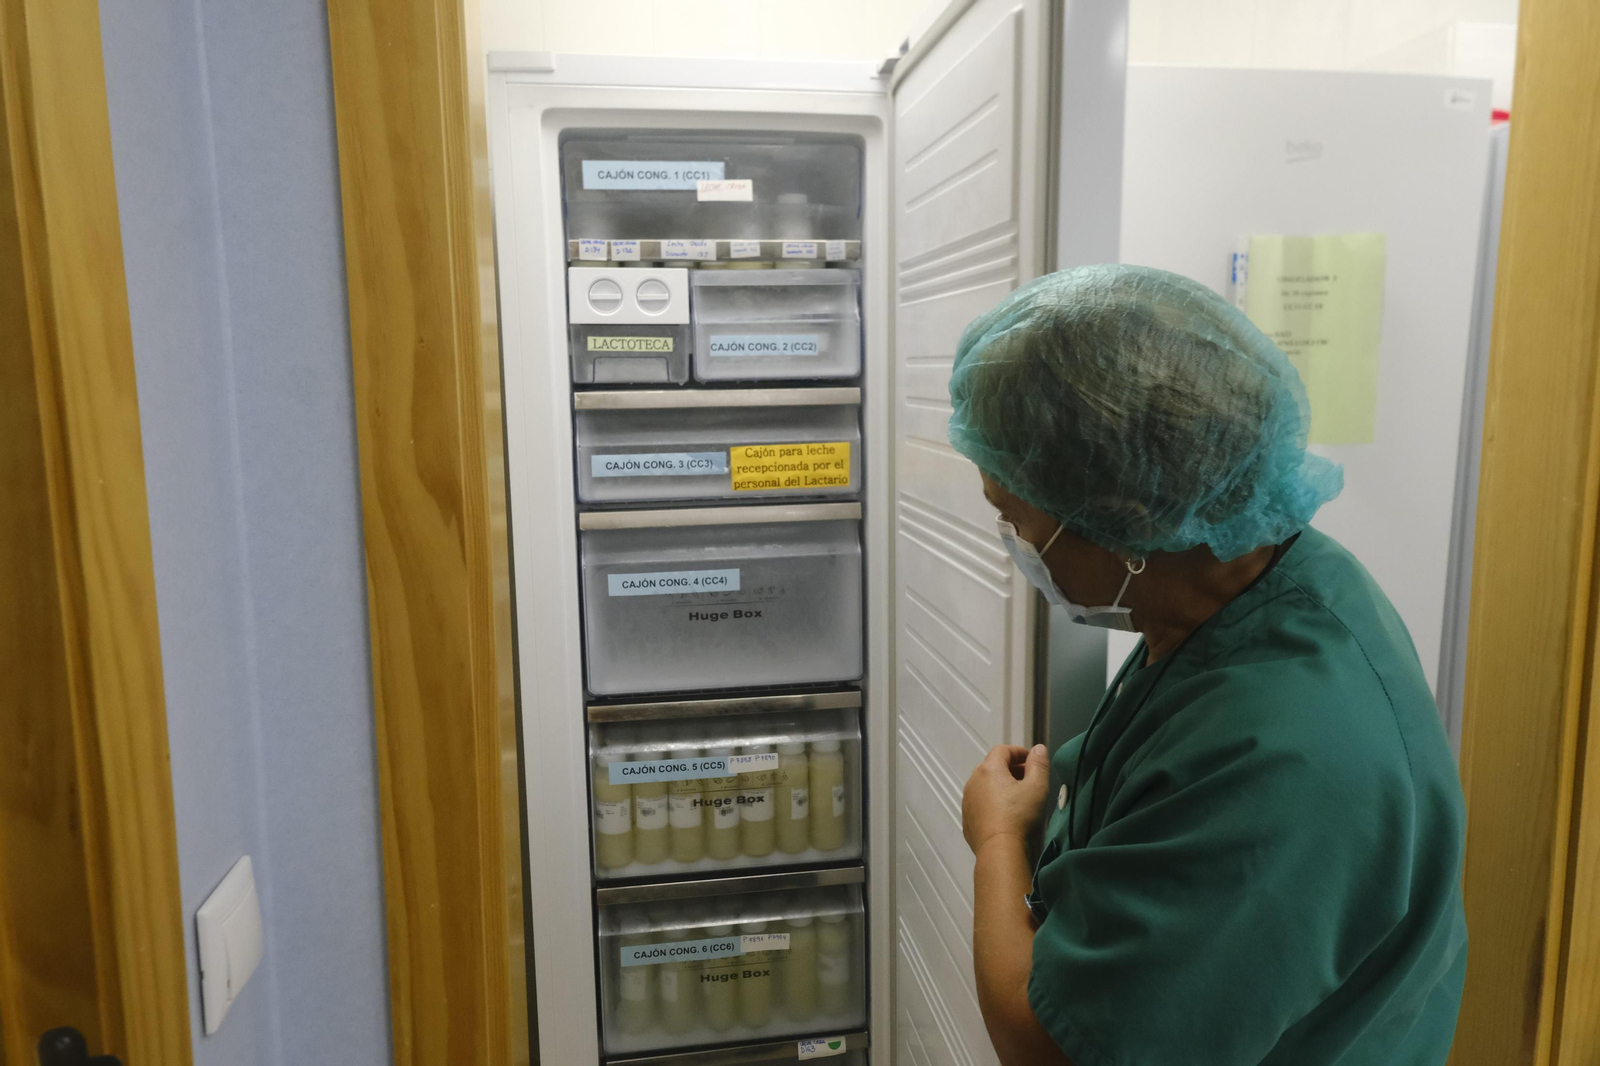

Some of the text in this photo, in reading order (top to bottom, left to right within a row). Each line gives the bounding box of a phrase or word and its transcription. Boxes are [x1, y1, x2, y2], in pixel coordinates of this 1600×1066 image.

[597, 168, 710, 181] CAJÓN CONG. 1 (CC1)
[592, 338, 671, 351] LACTOTECA
[710, 341, 817, 353] CAJÓN CONG. 2 (CC2)
[744, 445, 836, 459] Cajón para leche
[605, 459, 713, 471] CAJÓN CONG. 3 (CC3)
[736, 460, 844, 475] recepcionada por el
[734, 474, 848, 490] personal del Lactario
[622, 576, 728, 589] CAJÓN CONG. 4 (CC4)
[688, 609, 763, 622] Huge Box
[622, 760, 726, 776] CAJÓN CONG. 5 (CC5)
[693, 796, 732, 808] Huge
[736, 794, 765, 804] Box
[634, 942, 735, 960] CAJÓN CONG. 6 (CC6)
[700, 969, 771, 984] Huge Box
